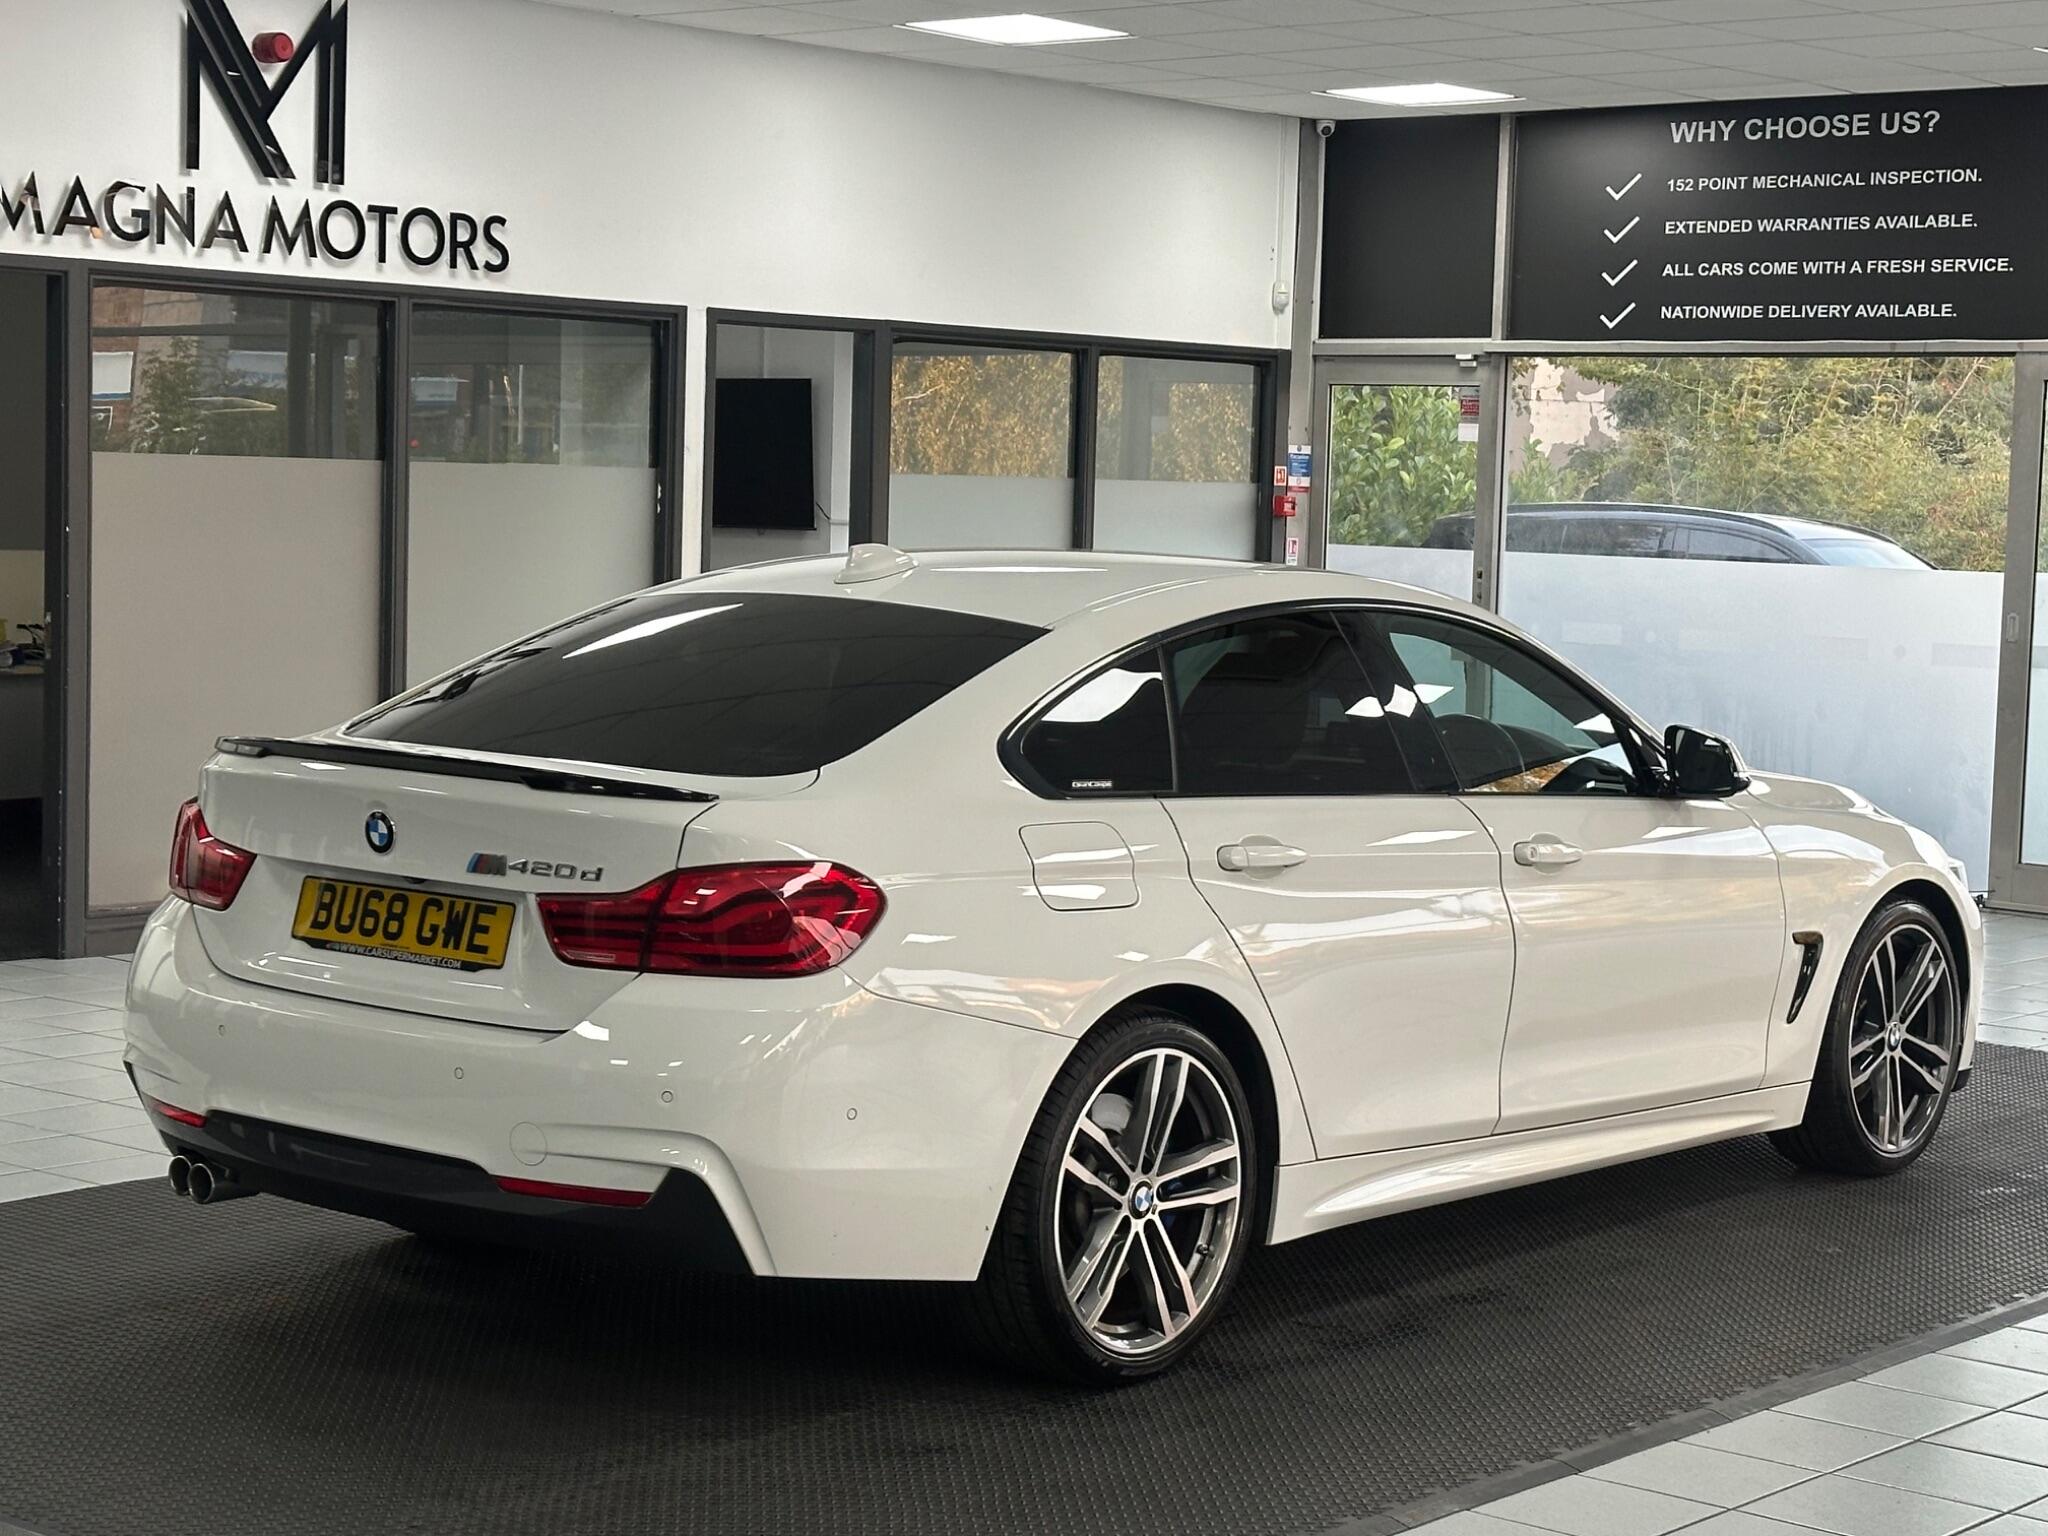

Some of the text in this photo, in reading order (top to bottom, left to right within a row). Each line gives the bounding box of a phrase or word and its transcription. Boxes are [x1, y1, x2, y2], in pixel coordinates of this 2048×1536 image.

[1670, 110, 1941, 144] WHY CHOOSE US?
[1666, 168, 1983, 193] 152 POINT MECHANICAL INSPECTION.
[0, 171, 510, 274] MAGNA MOTORS
[1664, 213, 1978, 235] EXTENDED WARRANTIES AVAILABLE.
[1662, 257, 2014, 277] ALL CARS COME WITH A FRESH SERVICE.
[1660, 303, 1957, 320] NATIONWIDE DELIVERY AVAILABLE.
[309, 882, 497, 955] BU68 GWE
